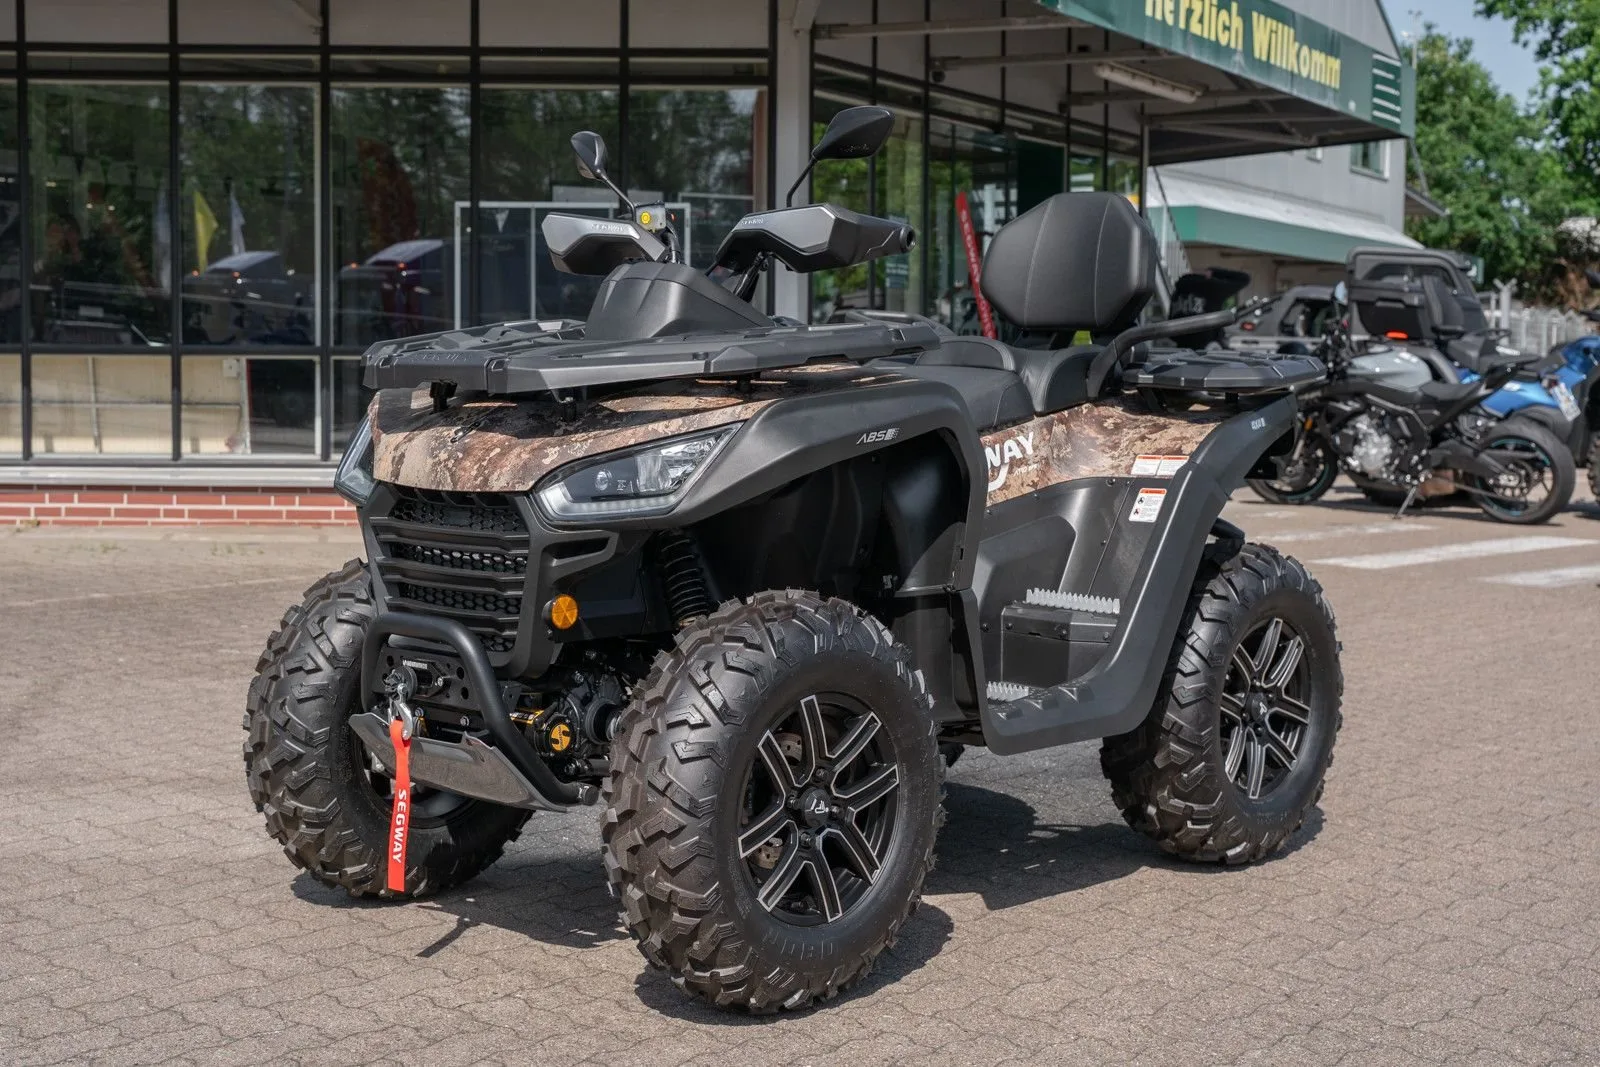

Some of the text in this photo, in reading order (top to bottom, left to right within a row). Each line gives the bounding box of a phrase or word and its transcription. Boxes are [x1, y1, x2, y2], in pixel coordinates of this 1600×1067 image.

[1252, 11, 1341, 89] Willkomm
[856, 430, 887, 445] ABS
[393, 788, 407, 864] SEGWAY
